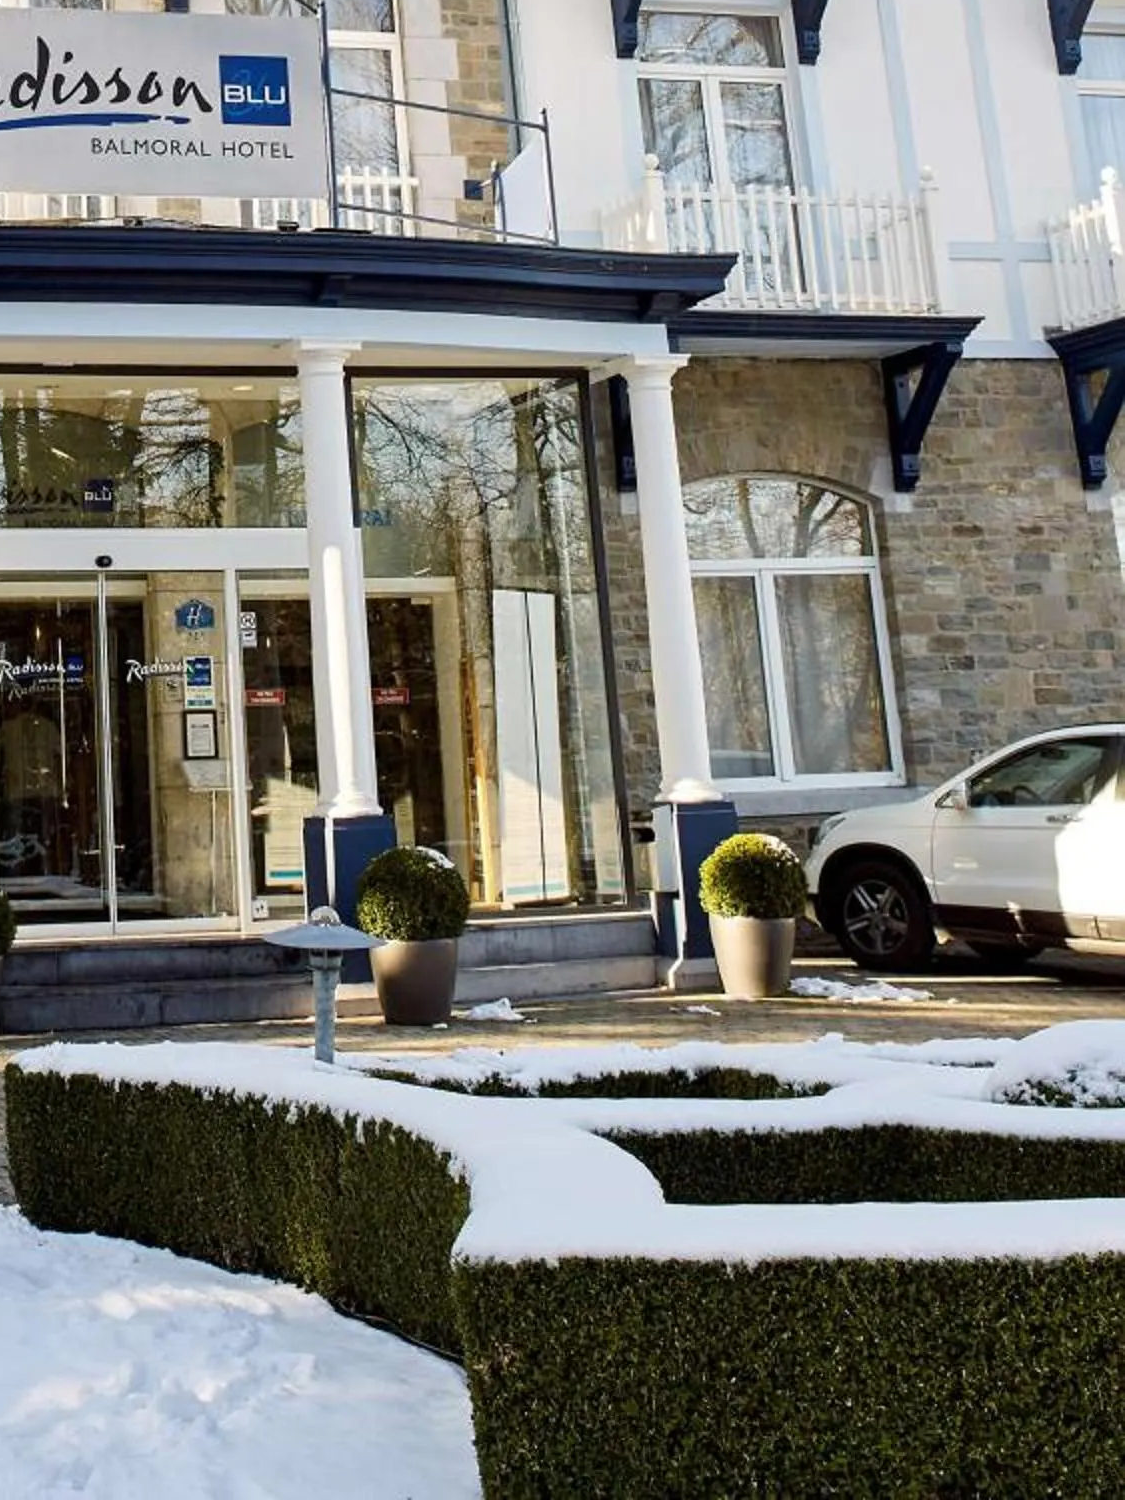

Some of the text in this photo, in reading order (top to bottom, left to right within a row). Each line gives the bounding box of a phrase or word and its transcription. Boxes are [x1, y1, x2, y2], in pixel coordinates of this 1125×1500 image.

[223, 84, 287, 105] BLU
[90, 137, 295, 160] BALMORAL HOTEL
